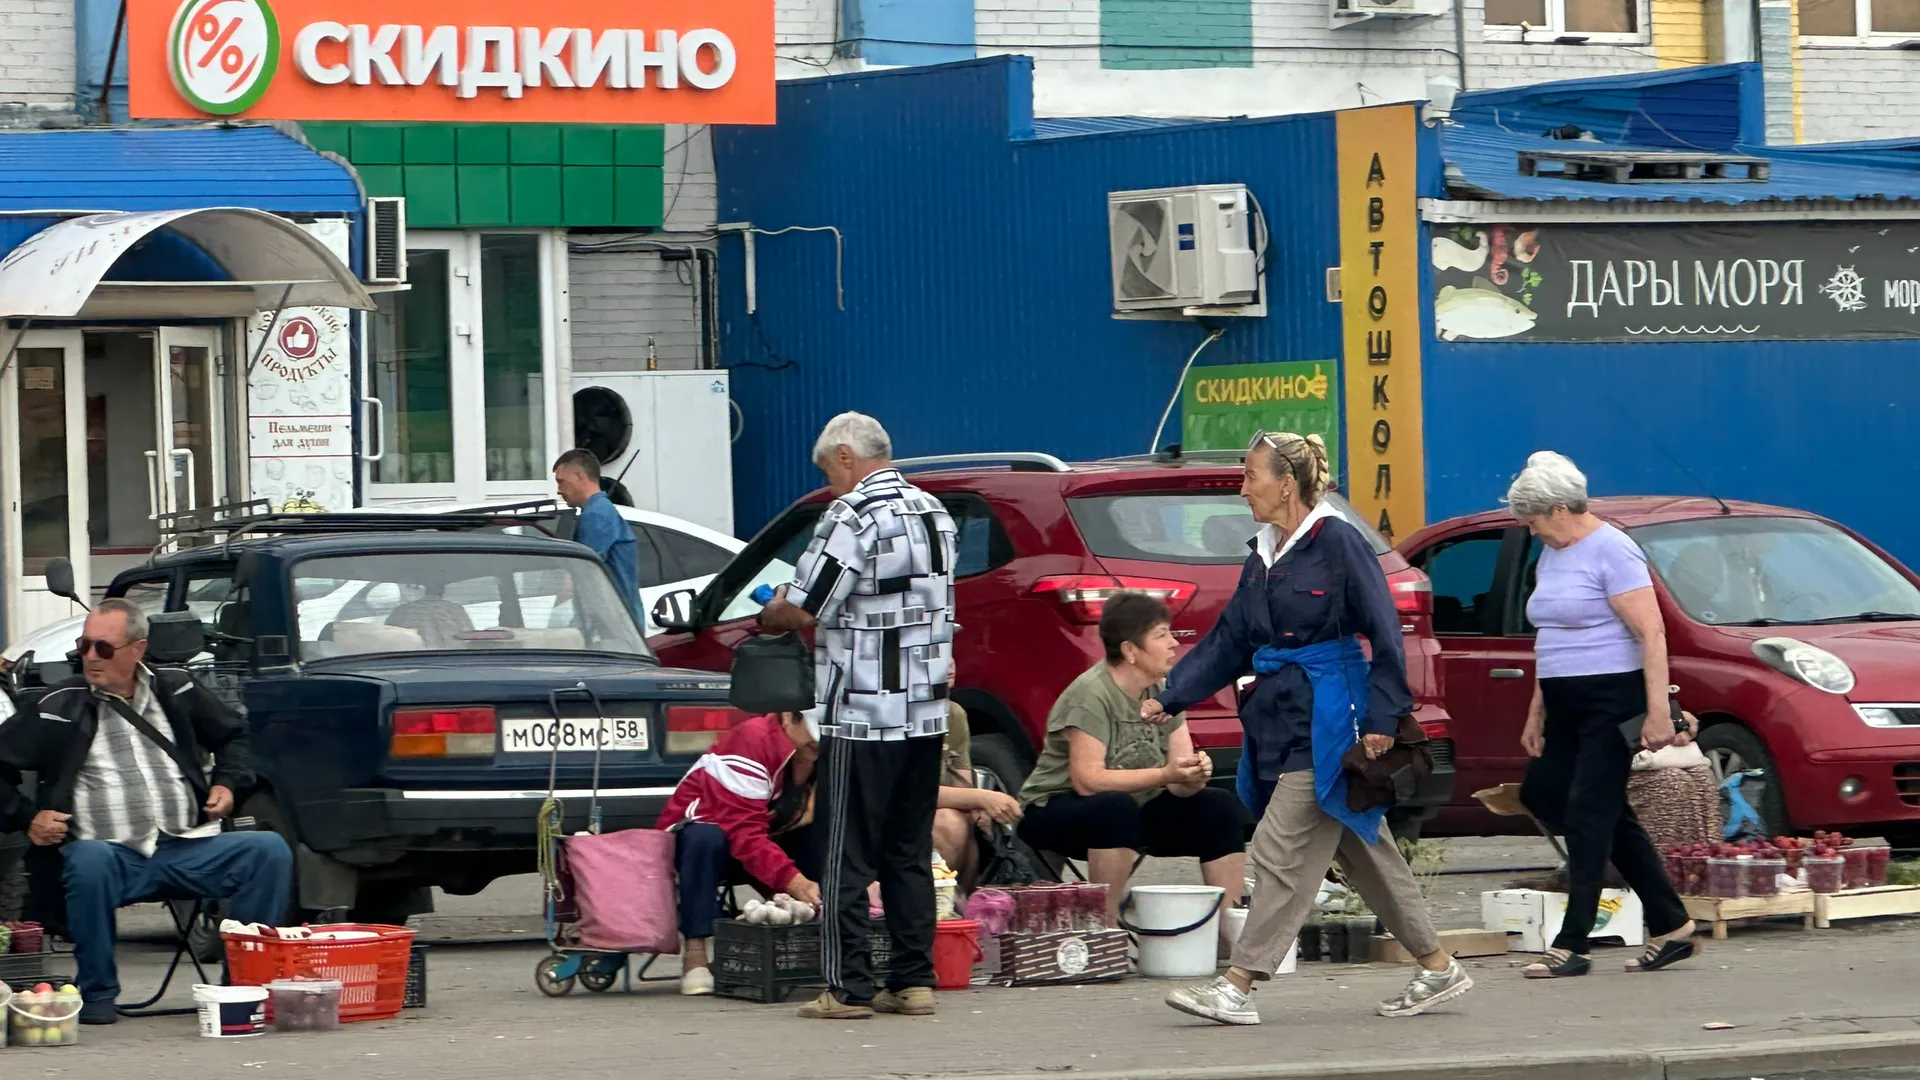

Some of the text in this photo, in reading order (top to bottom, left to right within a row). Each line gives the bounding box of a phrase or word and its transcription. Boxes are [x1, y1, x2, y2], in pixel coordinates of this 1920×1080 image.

[293, 20, 737, 98] СКИДКИНО
[1566, 258, 1805, 318] ДАРЫ МОРЯ
[1366, 152, 1395, 538] АВТОШКОЛА
[1195, 374, 1309, 406] СКИДКИНО
[615, 720, 638, 739] 58
